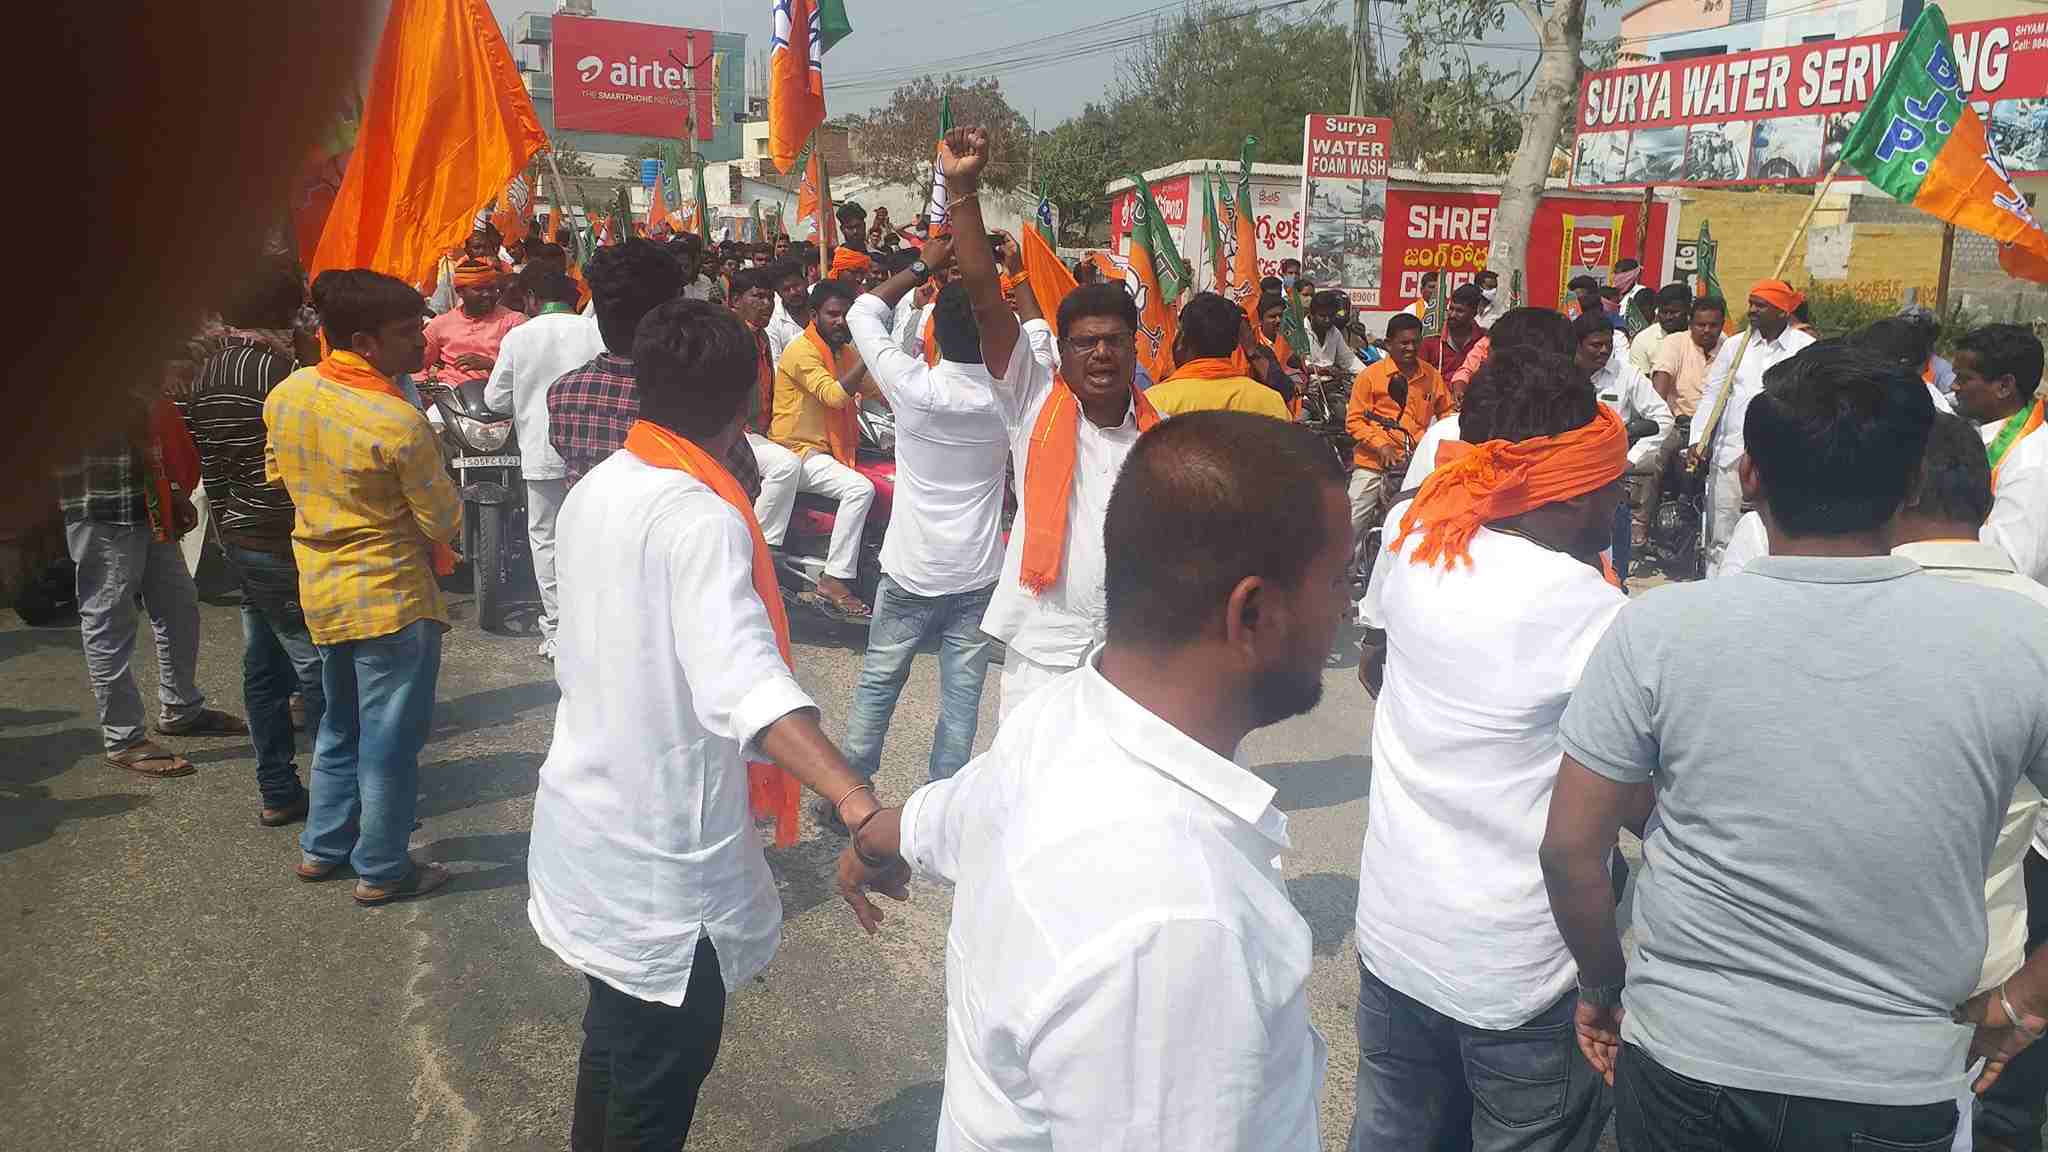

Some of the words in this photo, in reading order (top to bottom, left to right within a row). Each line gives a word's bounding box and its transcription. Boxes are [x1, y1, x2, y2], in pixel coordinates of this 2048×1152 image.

[610, 56, 694, 89] airtel
[1584, 70, 1672, 127] SURYA
[1681, 55, 1792, 117] WATER
[1800, 27, 2010, 104] SERVNG
[598, 91, 653, 104] SMARTPHONE
[1326, 117, 1377, 137] Surya
[1312, 139, 1385, 157] WATER
[1312, 157, 1347, 174] FOAM
[1350, 159, 1386, 176] WASH
